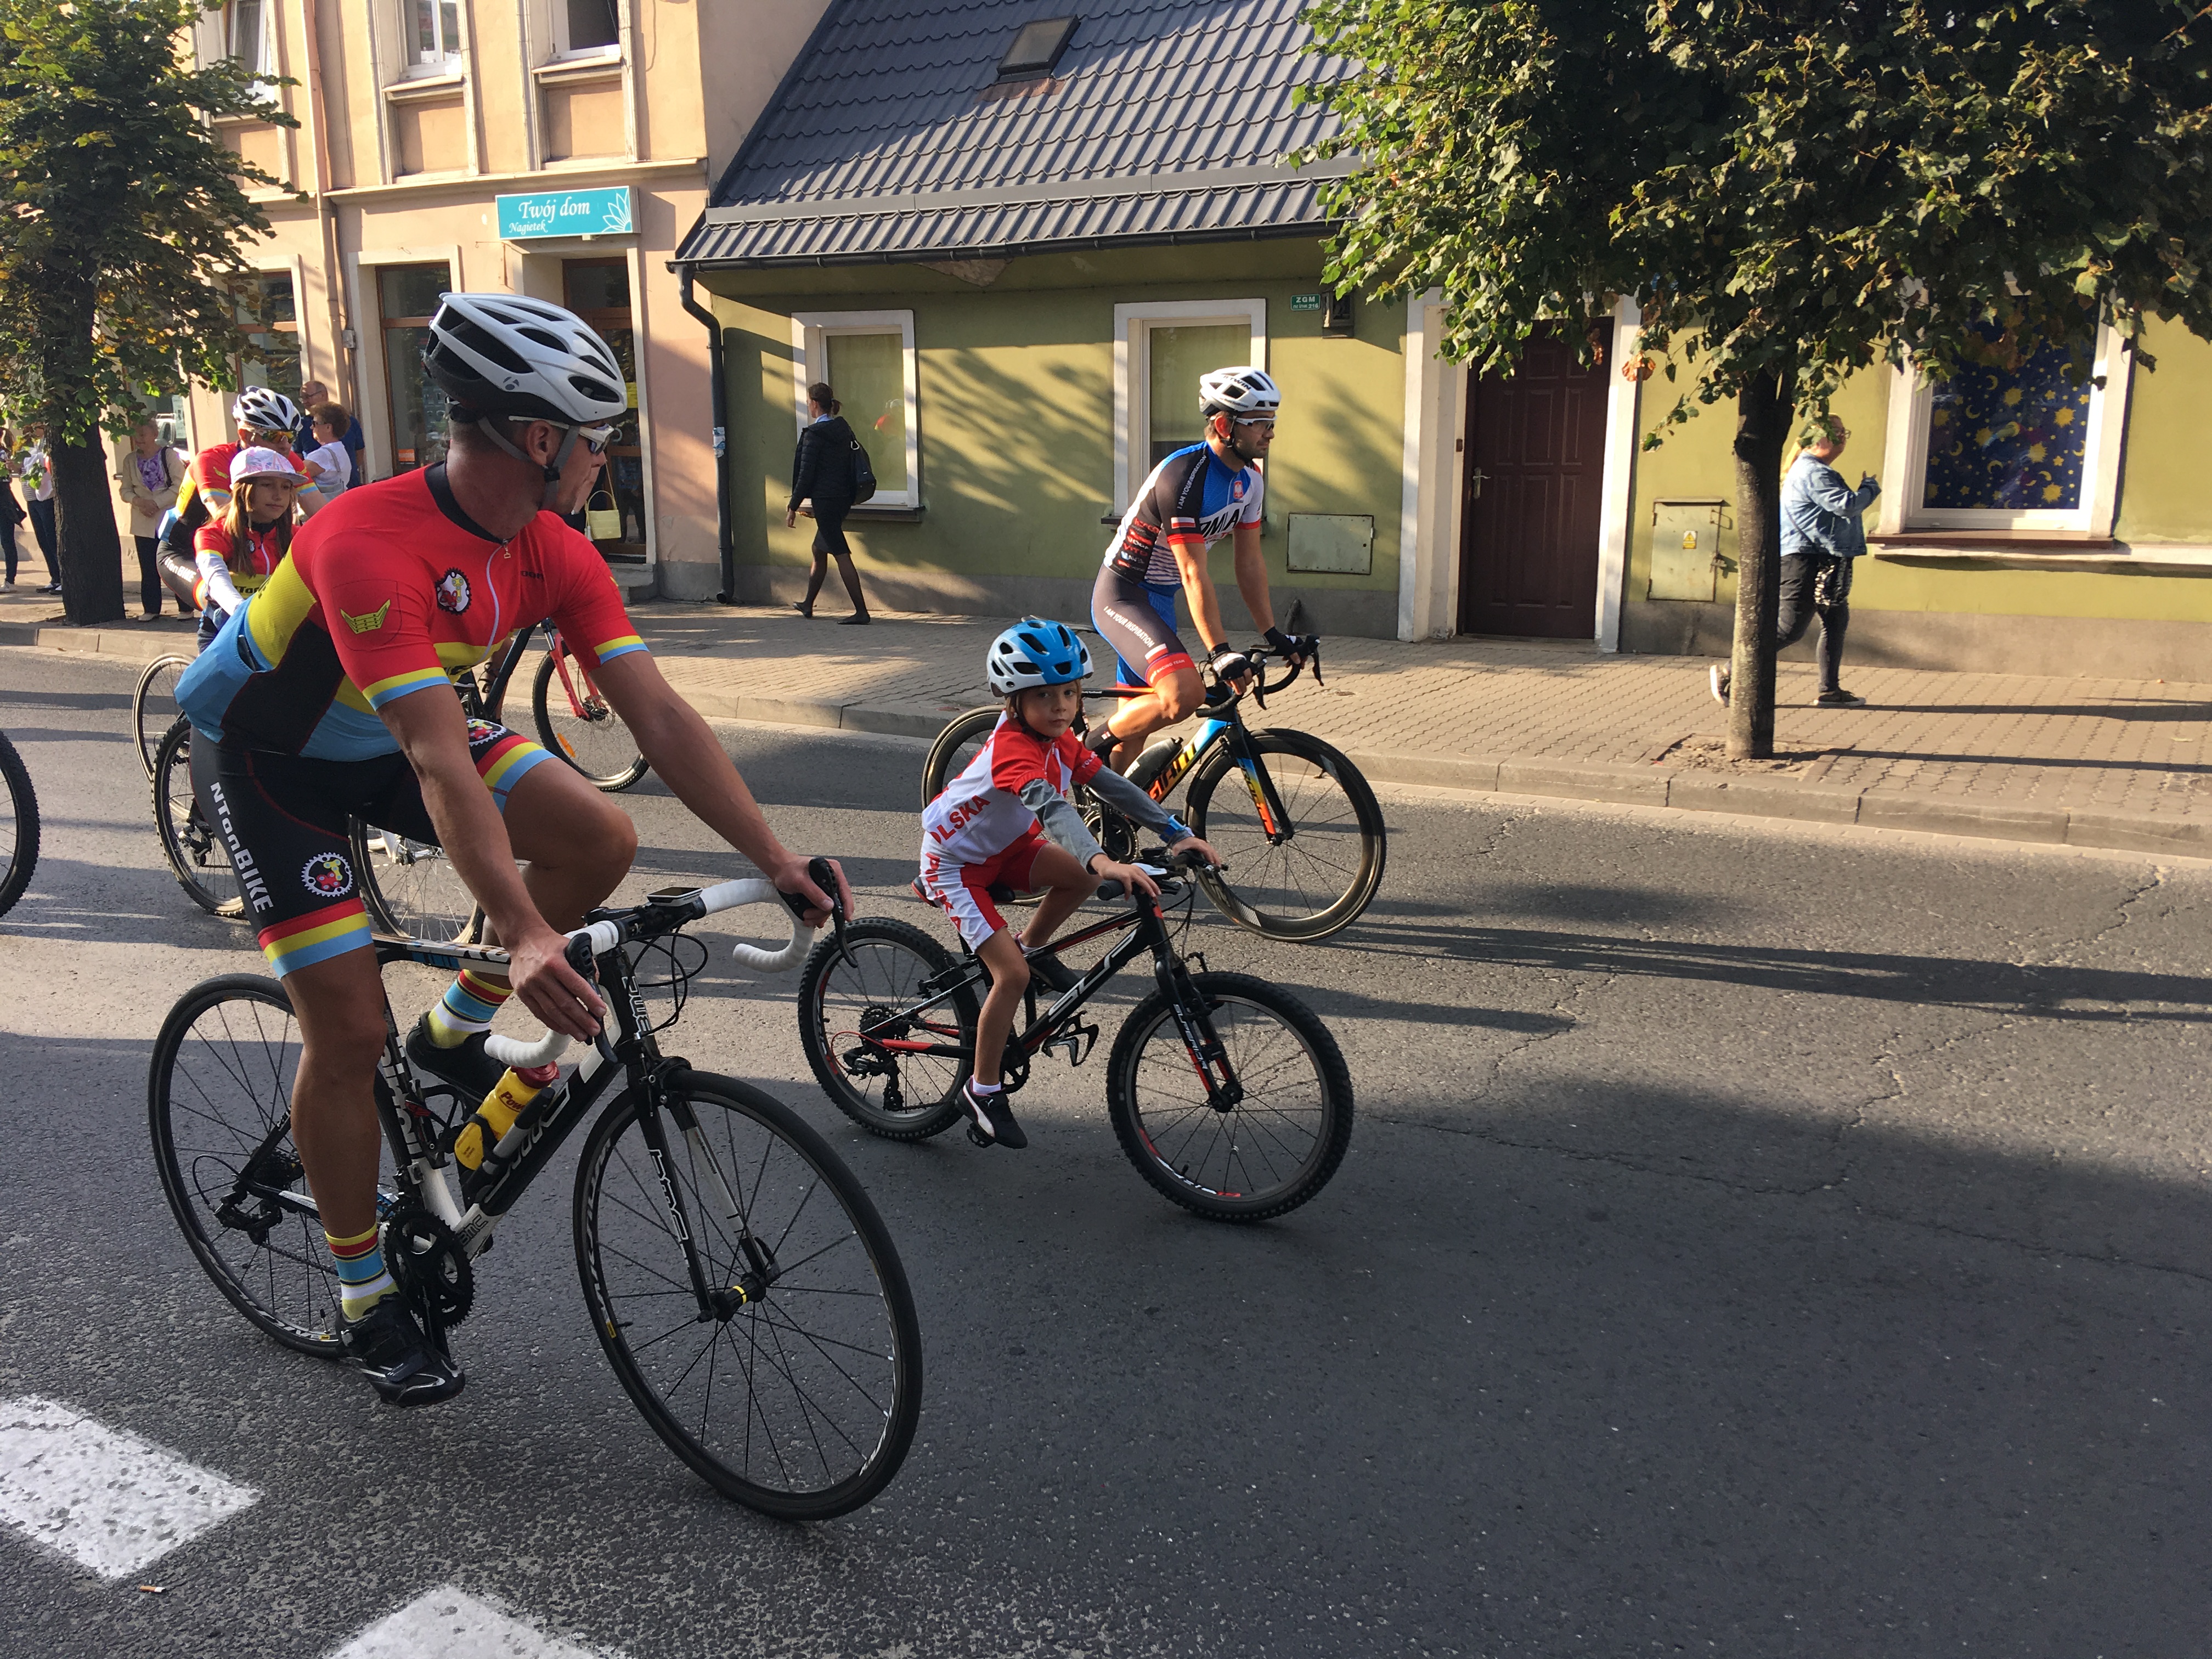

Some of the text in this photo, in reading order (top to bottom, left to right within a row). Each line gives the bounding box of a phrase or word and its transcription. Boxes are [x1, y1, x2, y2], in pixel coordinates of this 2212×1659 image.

[518, 196, 590, 223] Twój dom
[508, 219, 548, 235] Nagietek
[1105, 609, 1115, 618] AM
[1113, 613, 1128, 626] YOUR
[1125, 621, 1155, 648] INSPIRATION
[1156, 662, 1173, 673] RACING
[210, 782, 273, 913] NTonBIKE
[457, 1214, 489, 1246] BMC
